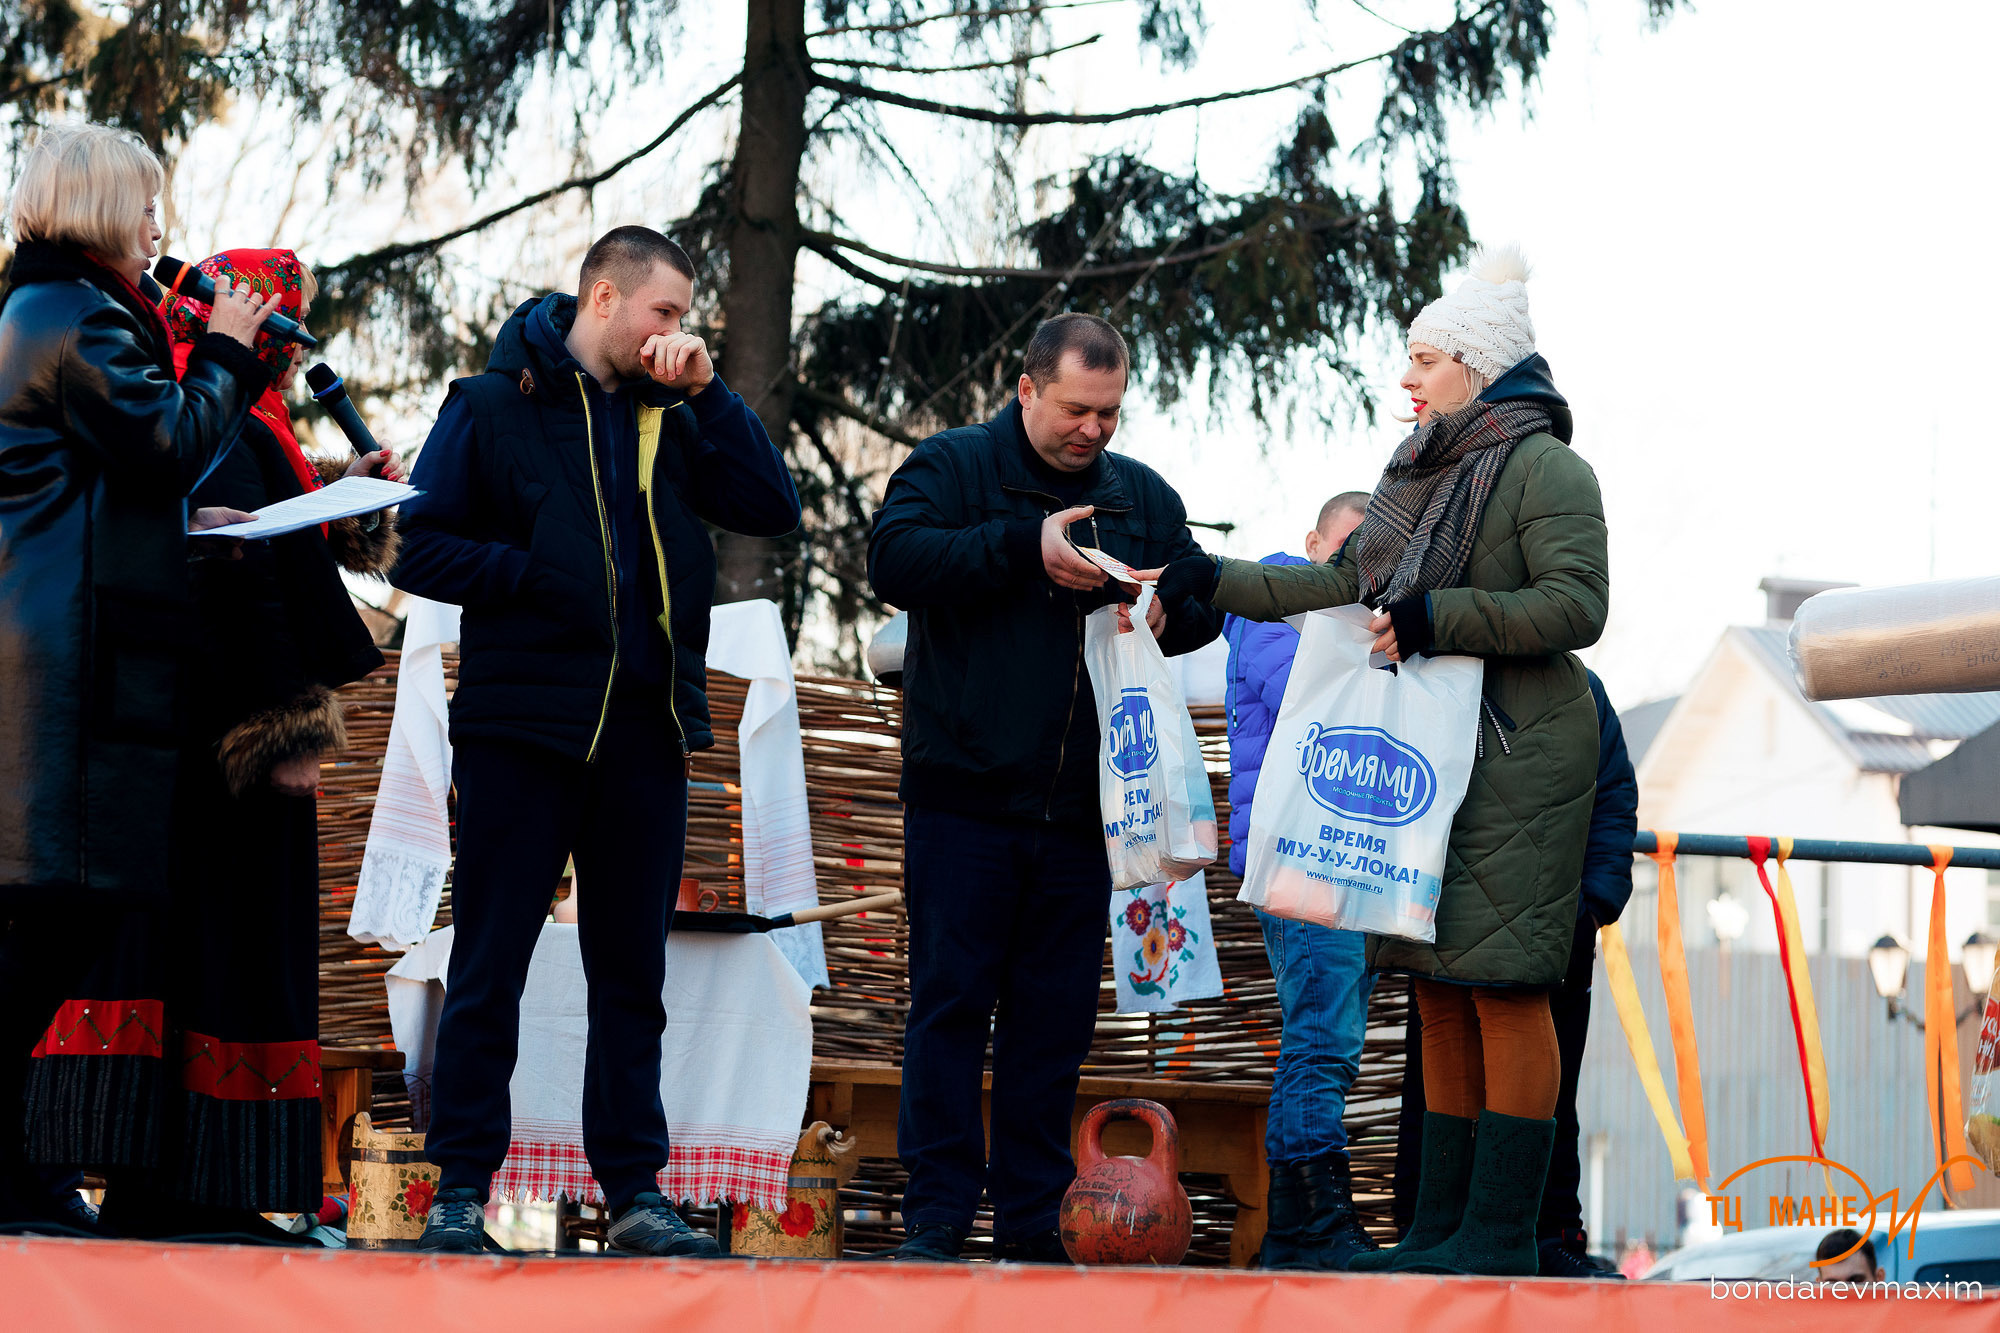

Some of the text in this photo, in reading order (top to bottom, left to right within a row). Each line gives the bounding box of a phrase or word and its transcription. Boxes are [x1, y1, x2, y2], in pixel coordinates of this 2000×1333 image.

[1332, 786, 1394, 808] МОЛОЧНЫЕ ПРОДУКТЫ
[1318, 824, 1387, 855] ВРЕМЯ
[1276, 837, 1419, 885] МУ-У-У-ЛОКА!
[1305, 869, 1384, 896] www.vremyamu.ru
